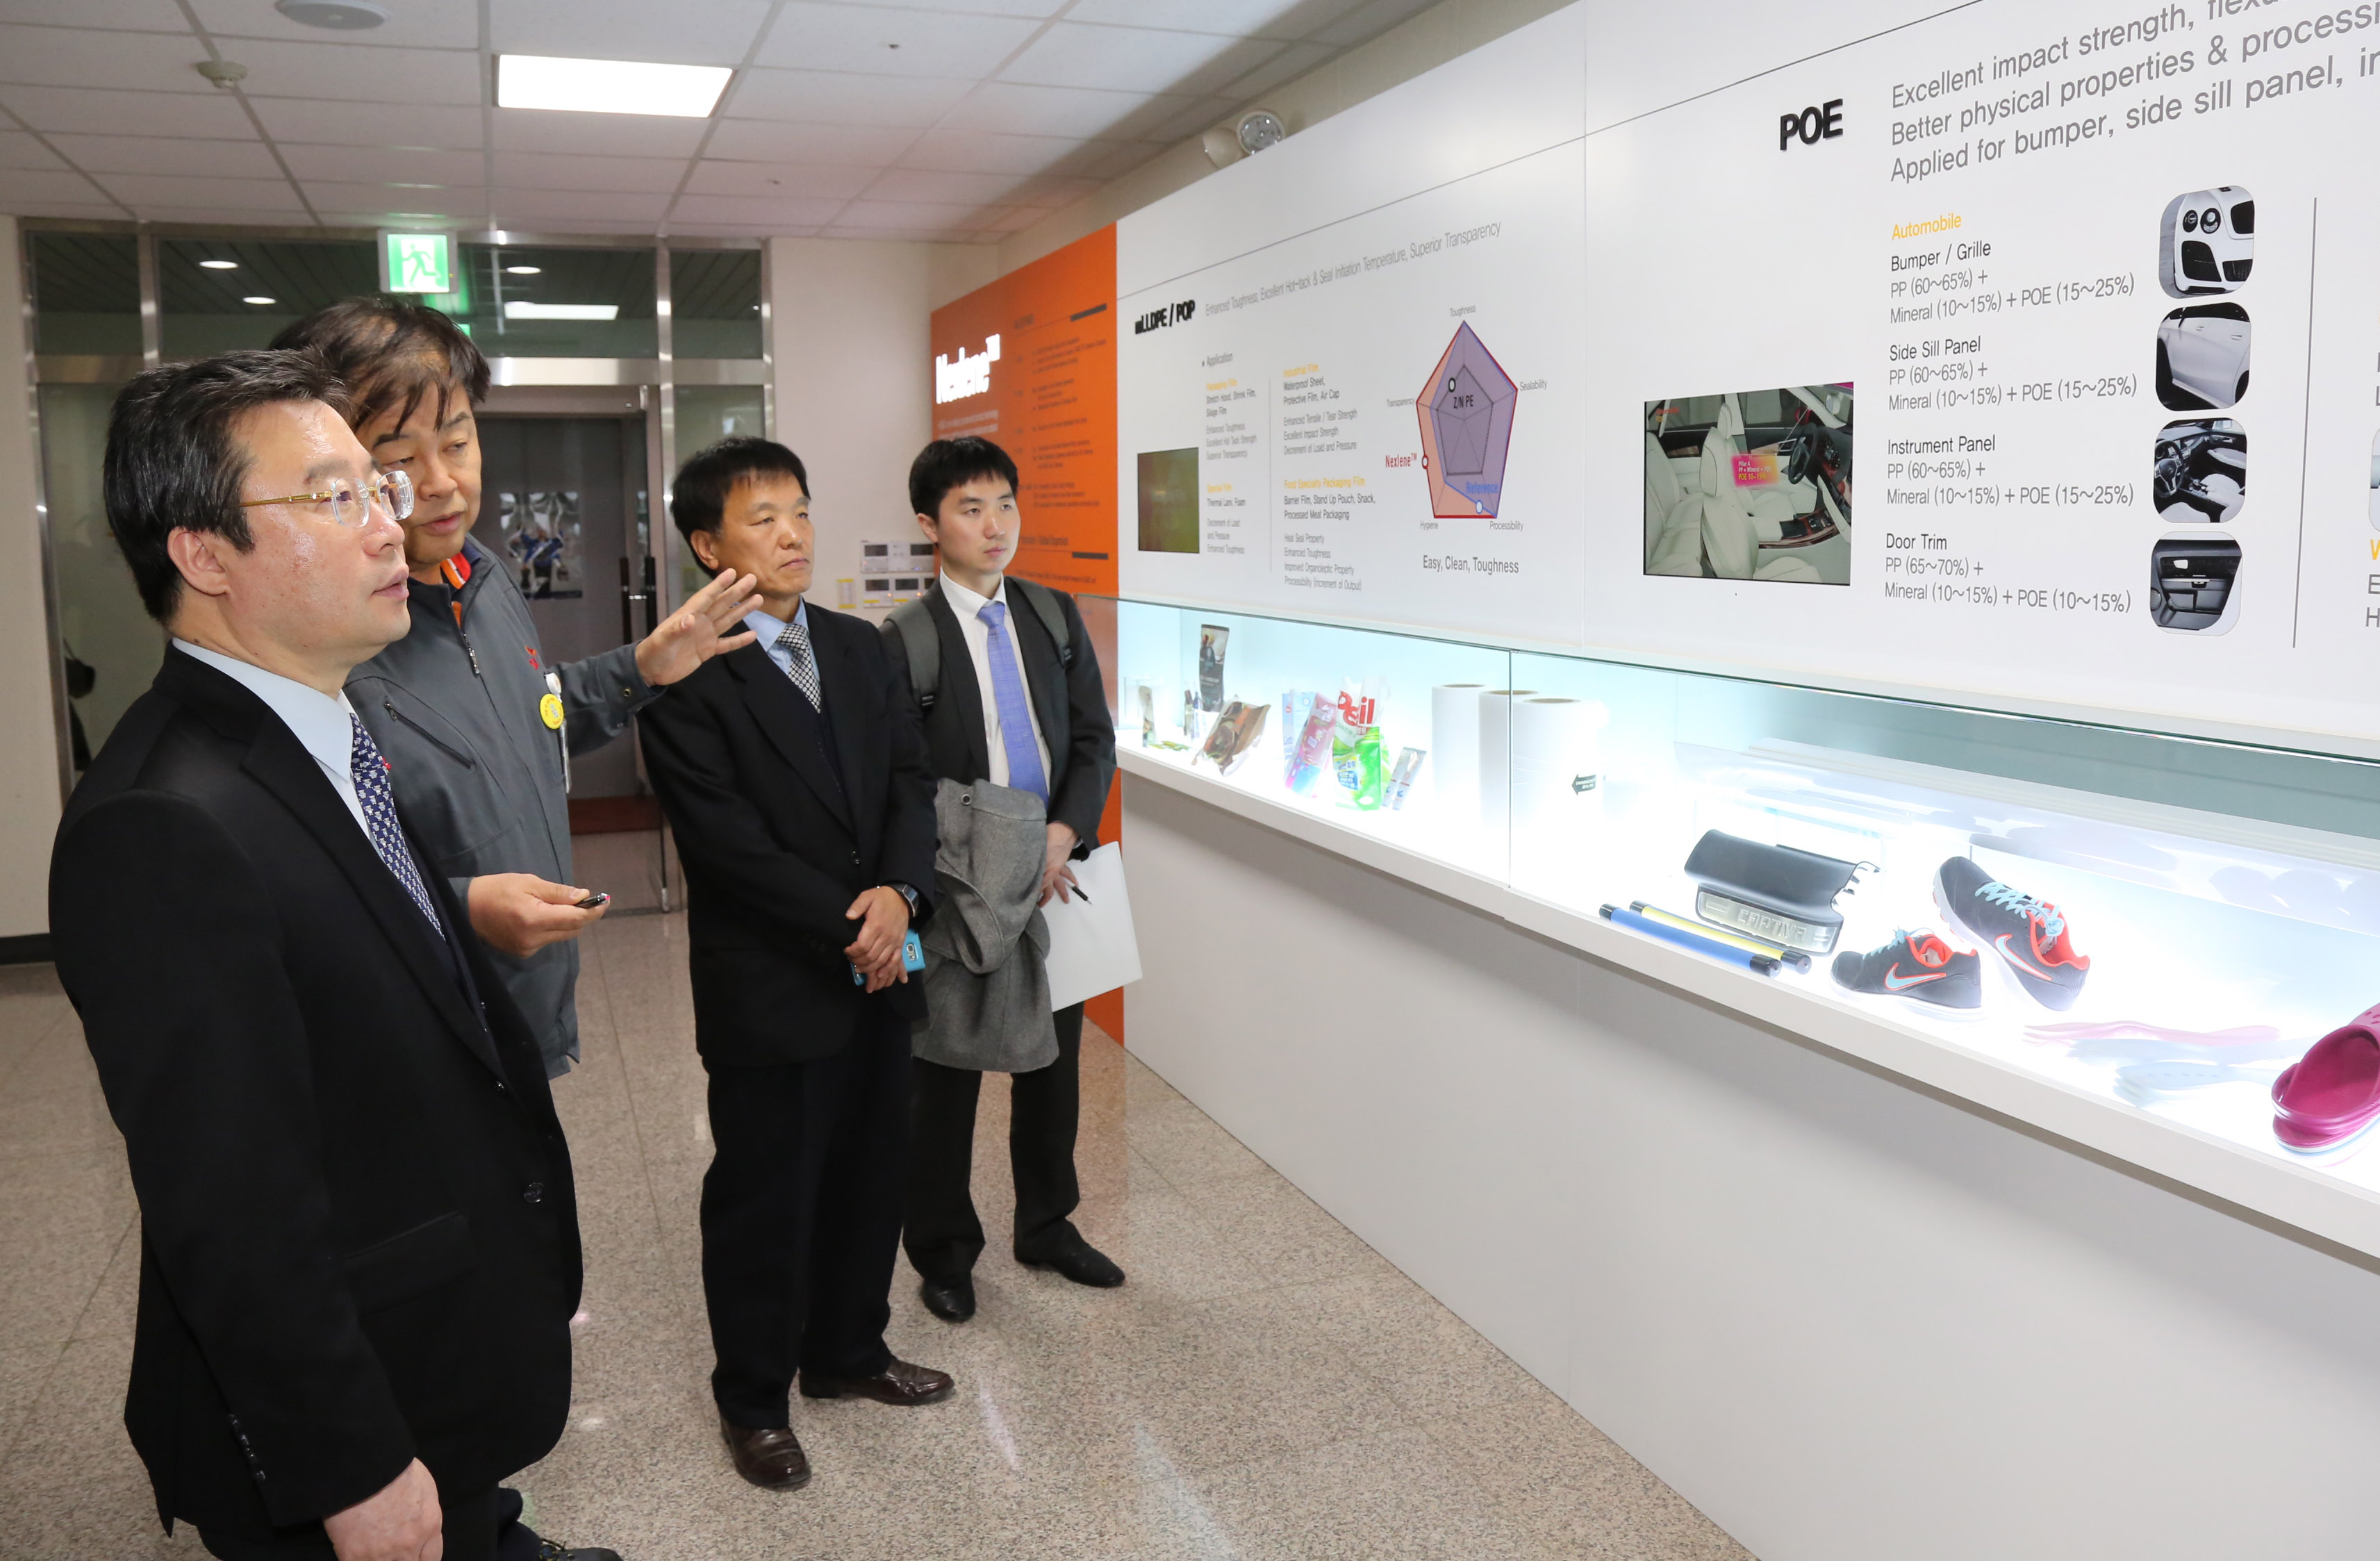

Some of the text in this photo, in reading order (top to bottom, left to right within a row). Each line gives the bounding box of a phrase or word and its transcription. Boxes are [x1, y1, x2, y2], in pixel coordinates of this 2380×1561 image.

[1892, 62, 1983, 108] Excellent
[1993, 36, 2068, 80] impact
[2079, 3, 2194, 56] strength,
[1892, 114, 1951, 145] Better
[1960, 81, 2049, 132] physical
[2060, 51, 2195, 107] properties
[2208, 35, 2228, 65] &
[1780, 99, 1843, 151] POE
[1891, 142, 1968, 183] Applied
[1978, 139, 2005, 163] for
[2015, 115, 2114, 154] bumper,
[2126, 95, 2182, 129] side
[2195, 80, 2231, 114] sill
[2246, 55, 2342, 108] panel,
[1892, 213, 1962, 240] Automobile
[1320, 267, 1333, 284] Seal
[1334, 262, 1361, 280] Initiation
[1363, 249, 1407, 272] Temperature,
[1410, 238, 1441, 258] Superior
[1445, 222, 1501, 249] Transparency
[1891, 240, 1991, 271] Bumper / Grille
[1891, 281, 1907, 298] PP
[1978, 270, 1988, 284] +
[1176, 299, 1196, 322] POP
[1450, 306, 1476, 317] Toughness
[1890, 304, 1932, 324] Mineral
[2006, 292, 2017, 307] +
[2021, 286, 2051, 306] POE
[1890, 336, 1981, 361] Side Sill Panel
[1207, 353, 1233, 367] Application
[1890, 370, 1906, 385] PP
[1978, 362, 1988, 377] +
[1519, 379, 1548, 392] Sealability
[1284, 395, 1306, 405] Protective
[1329, 389, 1339, 399] Cap
[1387, 397, 1415, 408] Transparency
[1466, 395, 1473, 407] PE
[1889, 392, 1931, 411] Mineral
[2007, 386, 2017, 402] +
[2022, 383, 2052, 402] POE
[1284, 416, 1305, 427] Enhanced
[1337, 409, 1357, 420] Strength
[1284, 427, 1338, 440] Excellent Impact Strength
[1307, 444, 1312, 453] of
[1314, 444, 1325, 452] Load
[1326, 443, 1334, 452] and
[1337, 441, 1357, 450] Pressure
[1887, 434, 1995, 454] Instrument Panel
[1887, 463, 1903, 479] PP
[1975, 462, 1985, 477] +
[1466, 481, 1498, 495] Reference
[1887, 488, 1930, 504] Mineral
[2005, 488, 2015, 504] +
[2020, 486, 2050, 504] POE
[1284, 495, 1300, 505] Barrier
[1314, 495, 1328, 504] Stand
[1329, 495, 1337, 505] Up
[1357, 493, 1375, 504] Snack,
[1284, 509, 1349, 520] Processed Meat Packaging
[1420, 521, 1439, 531] Hygiene
[1490, 521, 1524, 532] Processibility
[1295, 534, 1305, 543] Seal
[1306, 534, 1324, 545] Property
[1886, 533, 1947, 550] Door Trim
[1284, 547, 1331, 559] Enhanced Toughness
[1284, 562, 1304, 572] Improved
[1334, 564, 1354, 575] Property
[1423, 555, 1519, 575] Easy, Clean, Toughness
[1886, 557, 1901, 572] PP
[1974, 561, 1984, 576] +
[1339, 579, 1343, 589] of
[1885, 582, 1928, 600] Mineral
[2002, 590, 2013, 604] +
[2017, 589, 2047, 607] POE
[1737, 909, 1806, 942] CAPTIVA
